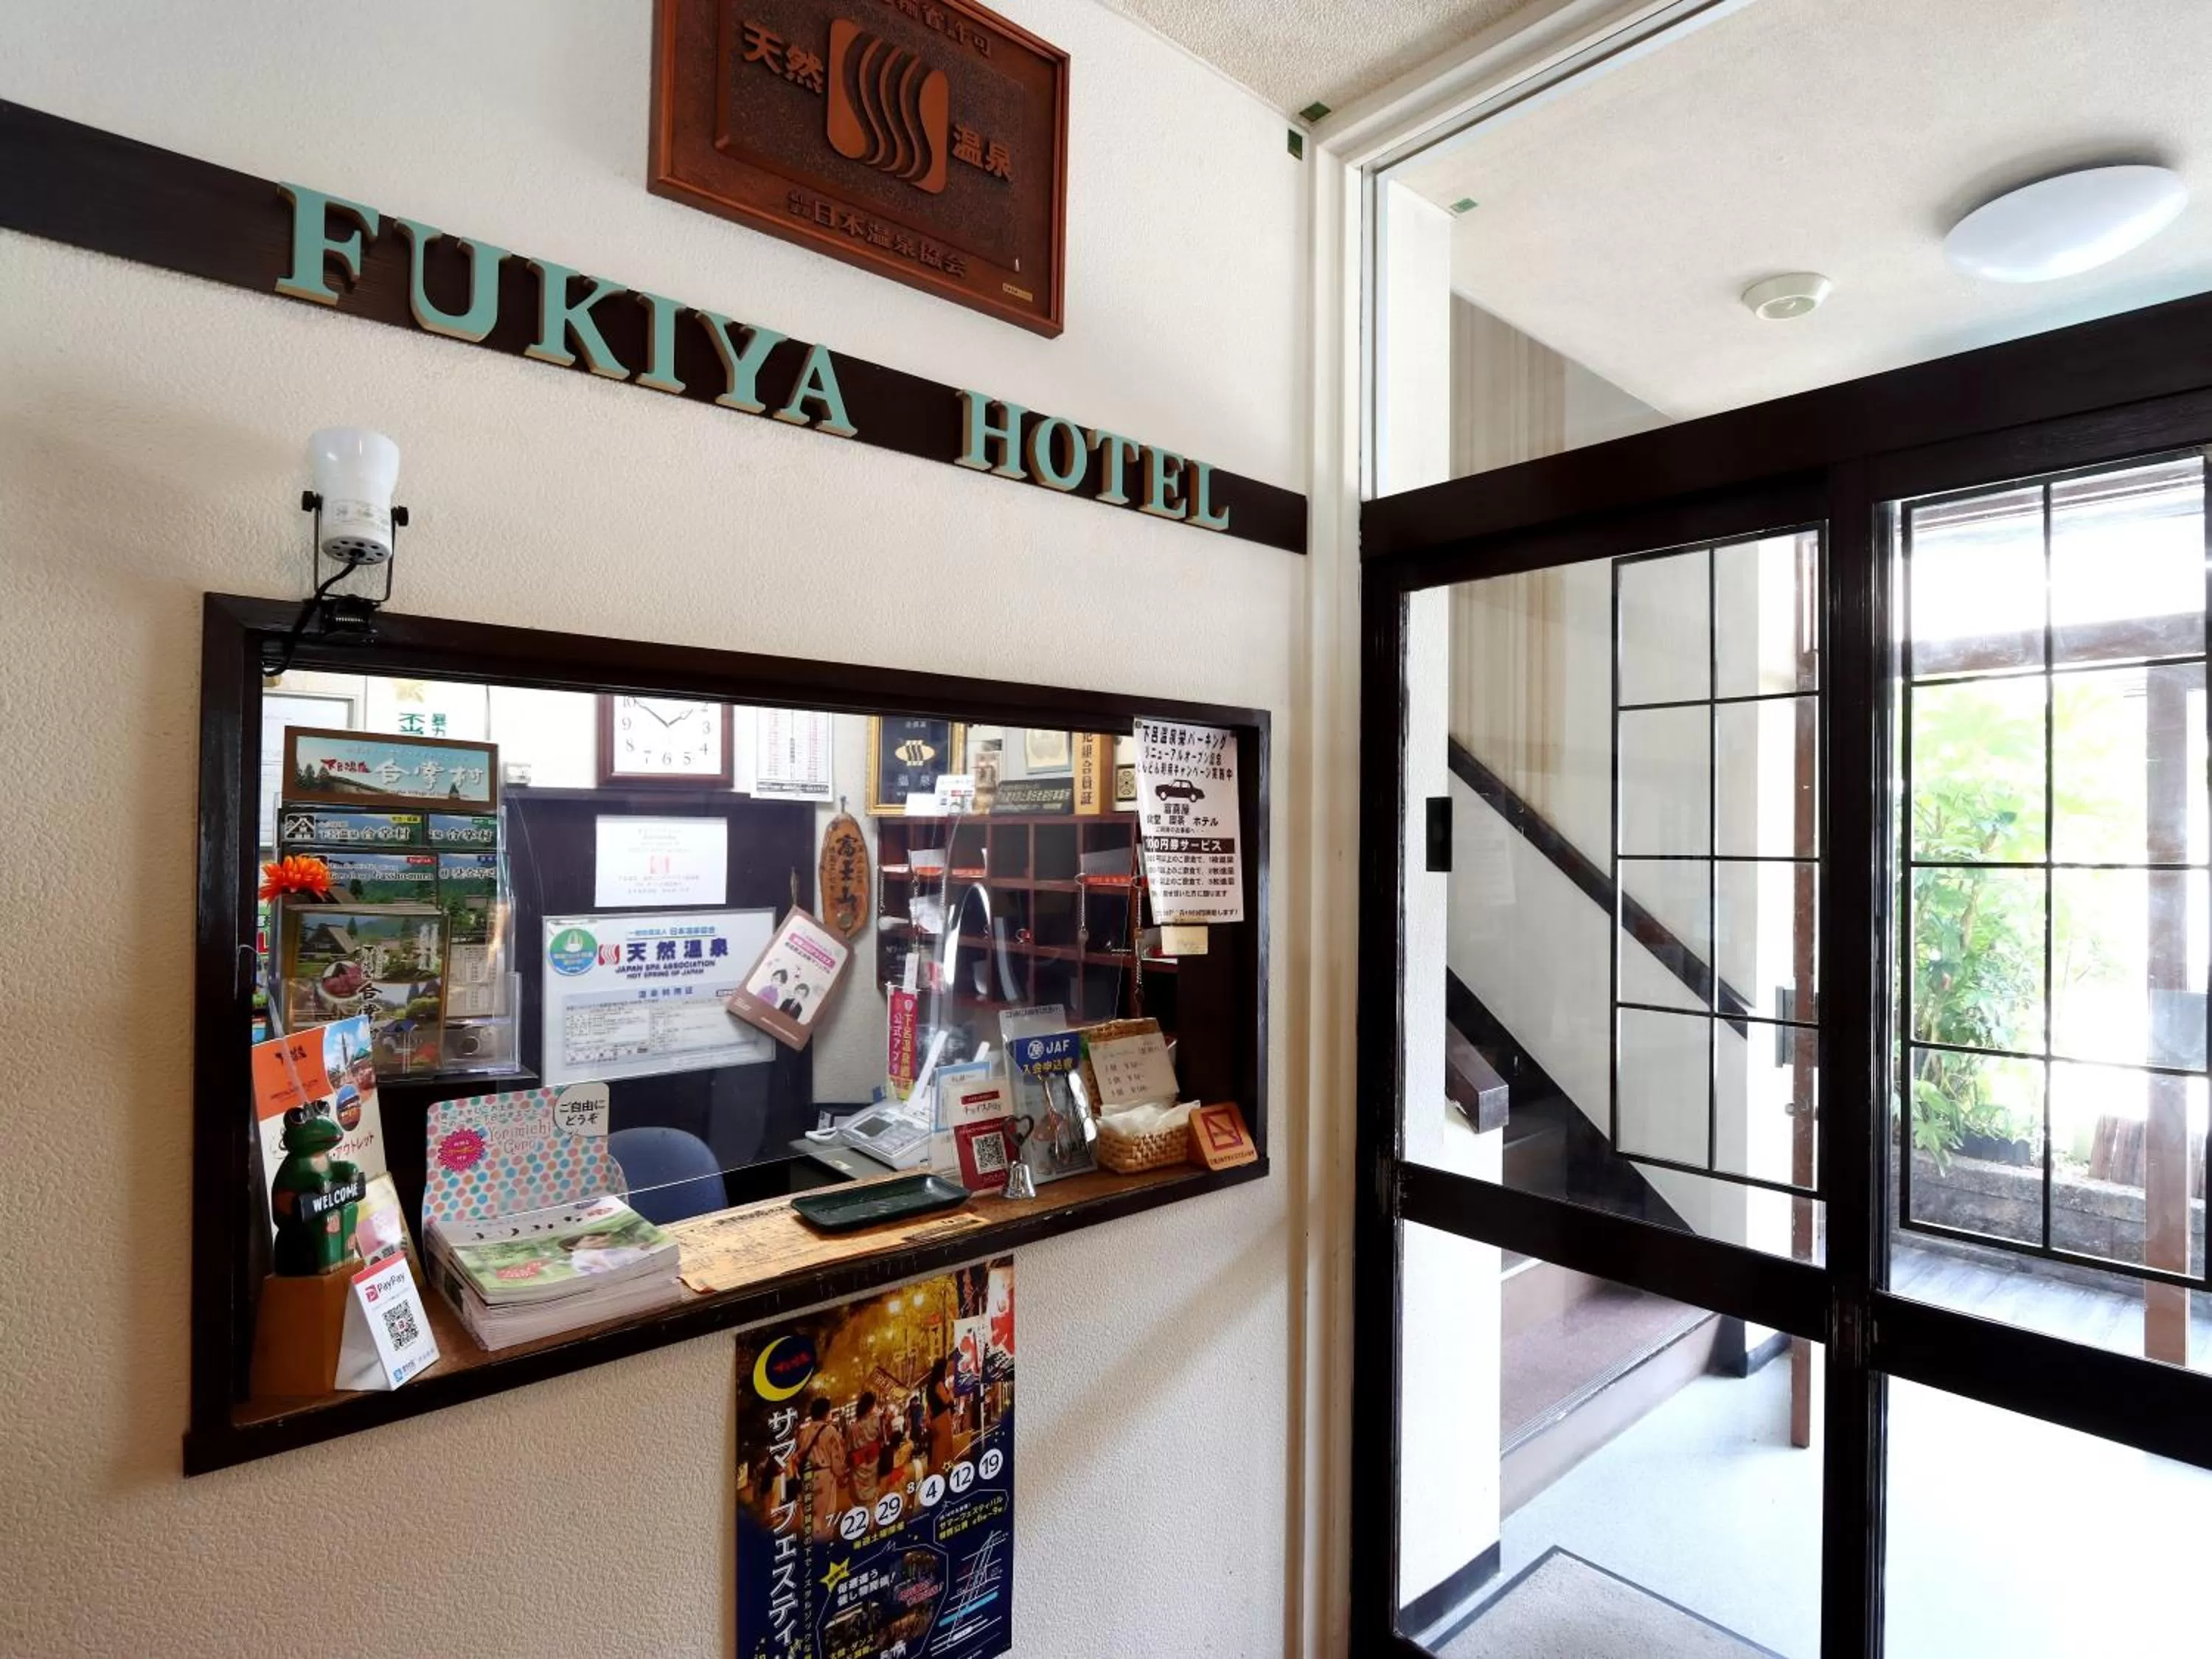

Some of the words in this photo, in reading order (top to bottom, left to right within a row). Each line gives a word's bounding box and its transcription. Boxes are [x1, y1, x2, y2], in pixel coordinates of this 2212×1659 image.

[741, 21, 824, 94] 天然
[950, 123, 1013, 182] 温泉
[274, 183, 858, 437] FUKIYA
[956, 388, 1233, 532] HOTEL
[621, 717, 633, 731] 9
[702, 721, 711, 735] 3
[626, 738, 635, 753] 8
[699, 742, 709, 756] 4
[643, 749, 653, 765] 7
[662, 751, 672, 765] 6
[684, 751, 692, 765] 5
[1193, 816, 1219, 827] ホテル
[626, 937, 728, 963] 天然温泉
[615, 964, 644, 974] JAPAN
[663, 960, 716, 970] ASSOCIATION
[644, 970, 669, 979] SPRING
[681, 968, 704, 976] JAPAN
[1046, 1039, 1071, 1054] JAF
[559, 1099, 605, 1114] ご自由に
[566, 1113, 599, 1127] どうぞ
[312, 1183, 359, 1213] WELCOME
[377, 1273, 406, 1295] PayPay
[844, 1511, 867, 1535] 22
[878, 1498, 900, 1520] 29
[925, 1481, 938, 1499] 4
[953, 1467, 972, 1488] 12
[981, 1455, 999, 1473] 19
[767, 1406, 799, 1659] サマーフェスティ
